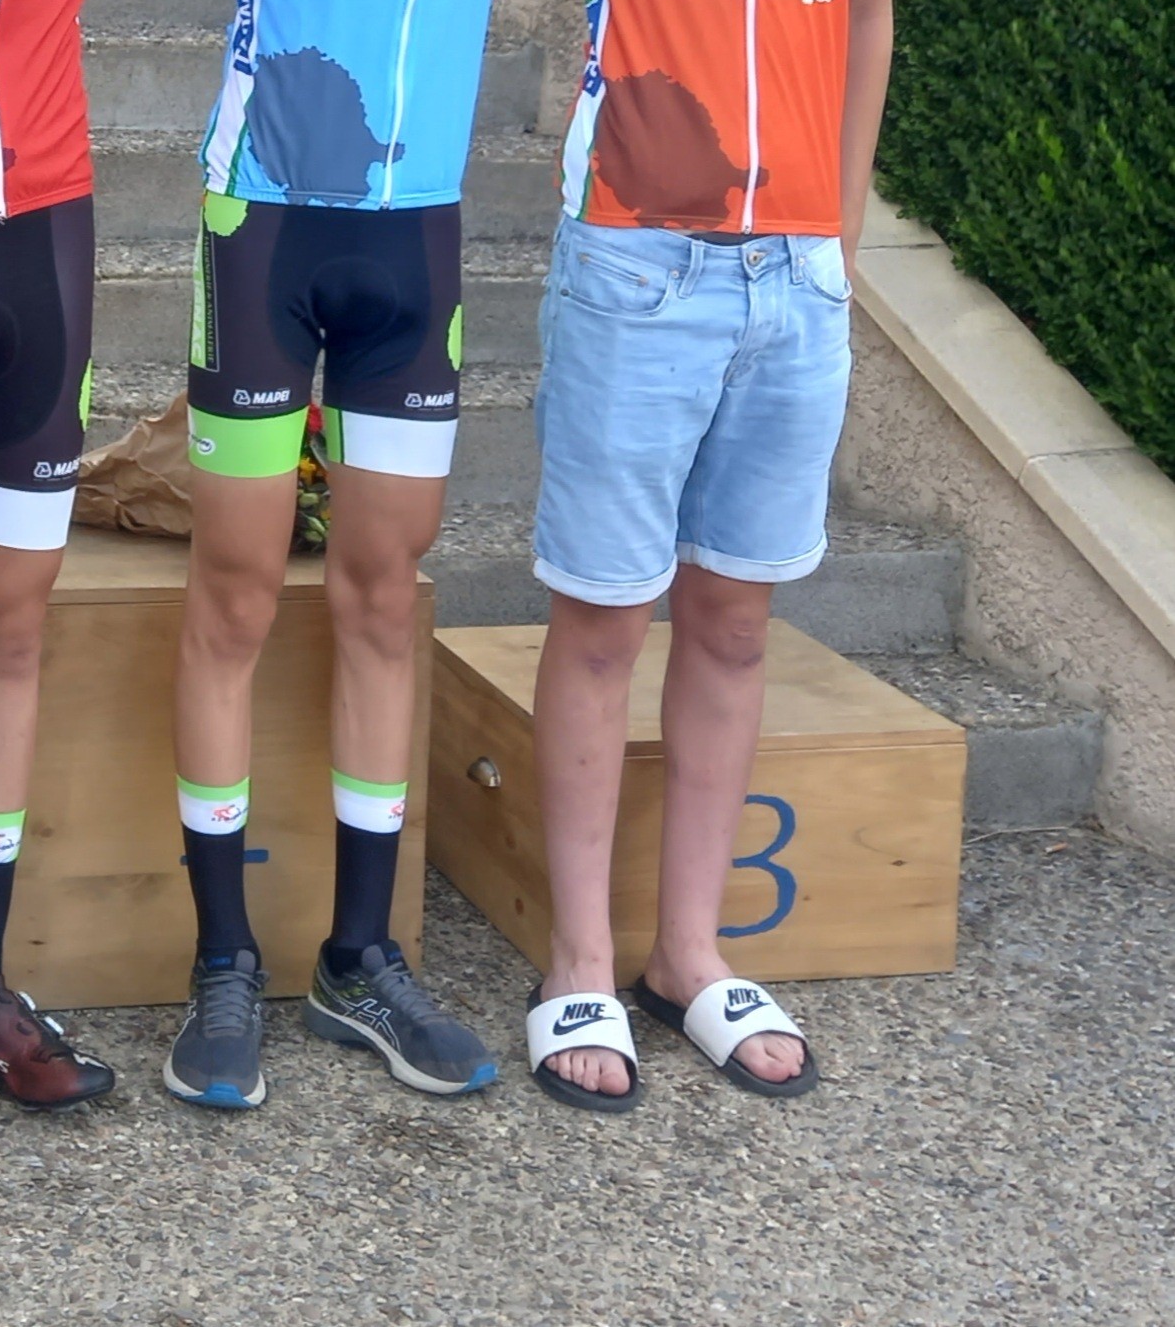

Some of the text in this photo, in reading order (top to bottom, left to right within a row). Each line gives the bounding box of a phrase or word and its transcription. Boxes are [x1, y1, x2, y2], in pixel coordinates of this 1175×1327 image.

[252, 389, 291, 405] MAPEI
[717, 793, 797, 939] 3
[727, 987, 764, 1007] NIKE
[562, 1003, 607, 1022] NIKE
